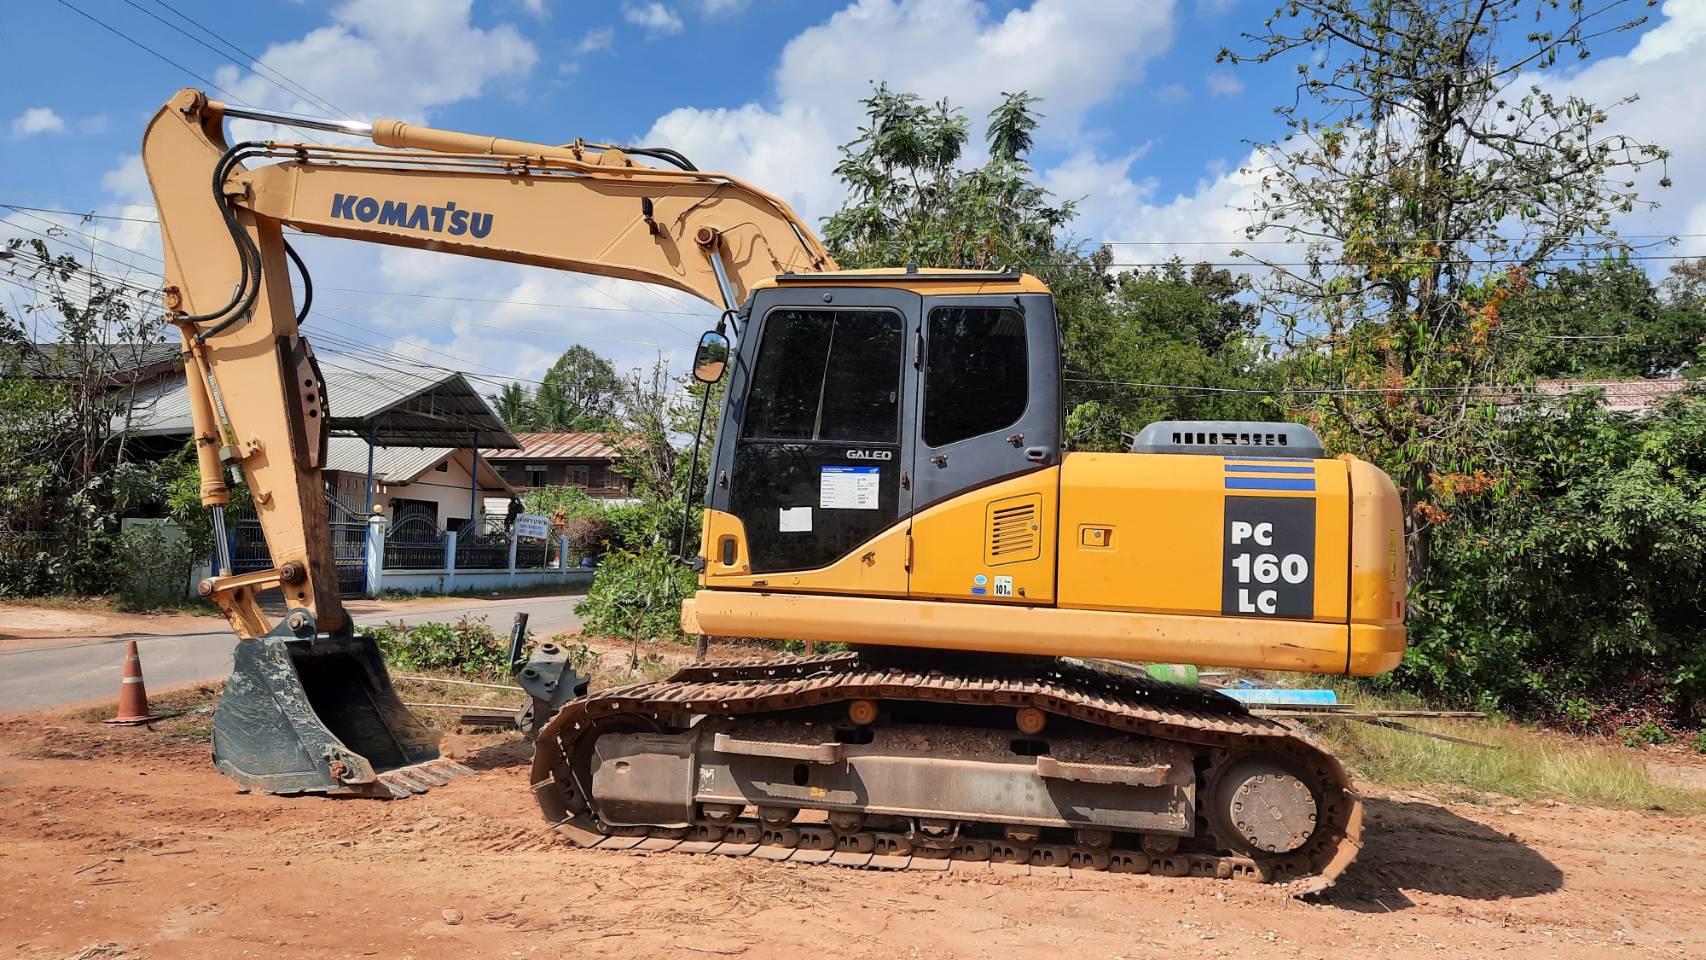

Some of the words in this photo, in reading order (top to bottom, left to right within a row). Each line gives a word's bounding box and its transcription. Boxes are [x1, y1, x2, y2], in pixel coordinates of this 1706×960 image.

[331, 194, 493, 238] KOMATSU
[846, 450, 892, 460] GALEO
[1231, 521, 1272, 546] PC
[1232, 553, 1308, 584] 160
[1238, 588, 1277, 615] LC
